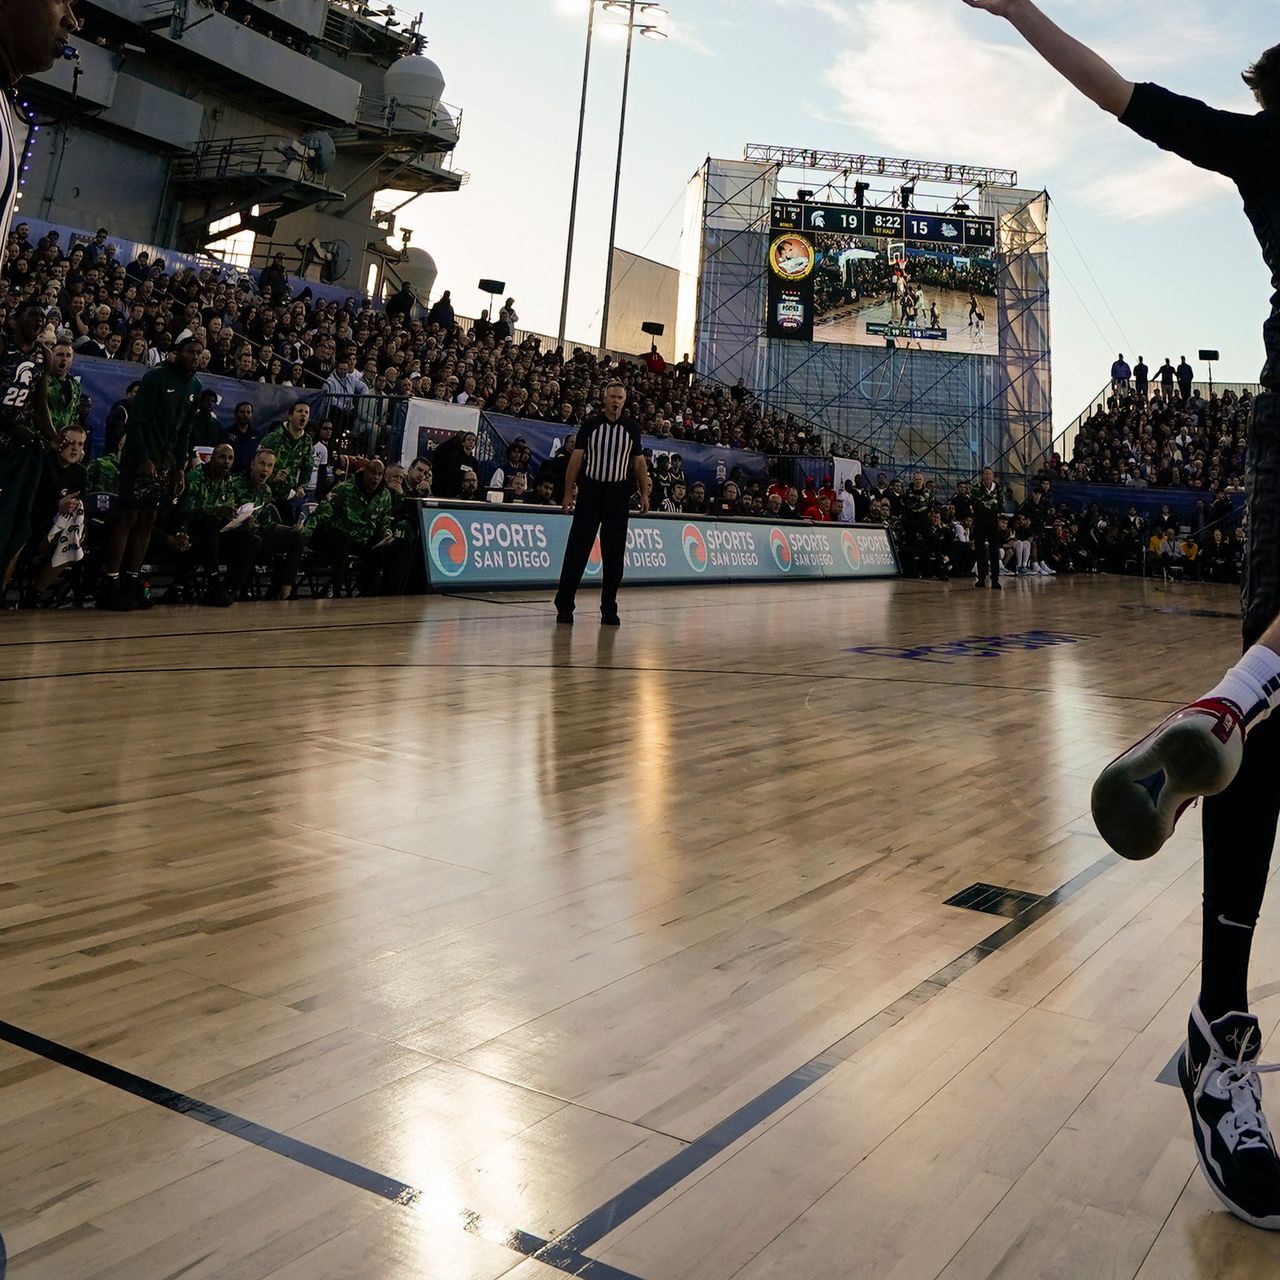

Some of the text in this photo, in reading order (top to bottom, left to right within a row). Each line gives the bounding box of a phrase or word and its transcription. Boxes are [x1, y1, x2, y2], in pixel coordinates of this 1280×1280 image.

[840, 214, 857, 228] 19
[874, 214, 901, 228] 8:22
[911, 221, 928, 234] 15
[2, 387, 30, 407] 22
[470, 522, 548, 548] SPORTS
[626, 527, 663, 550] ORTS
[706, 529, 755, 550] SPORTS
[789, 532, 830, 551] SPORTS
[856, 534, 891, 551] SPORTS
[473, 550, 550, 568] SAN DIEGO
[633, 552, 667, 567] DIEGO
[710, 552, 758, 566] SAN DIEGO
[794, 553, 833, 566] SAN DIEGO
[862, 553, 895, 565] SAN DIEGO
